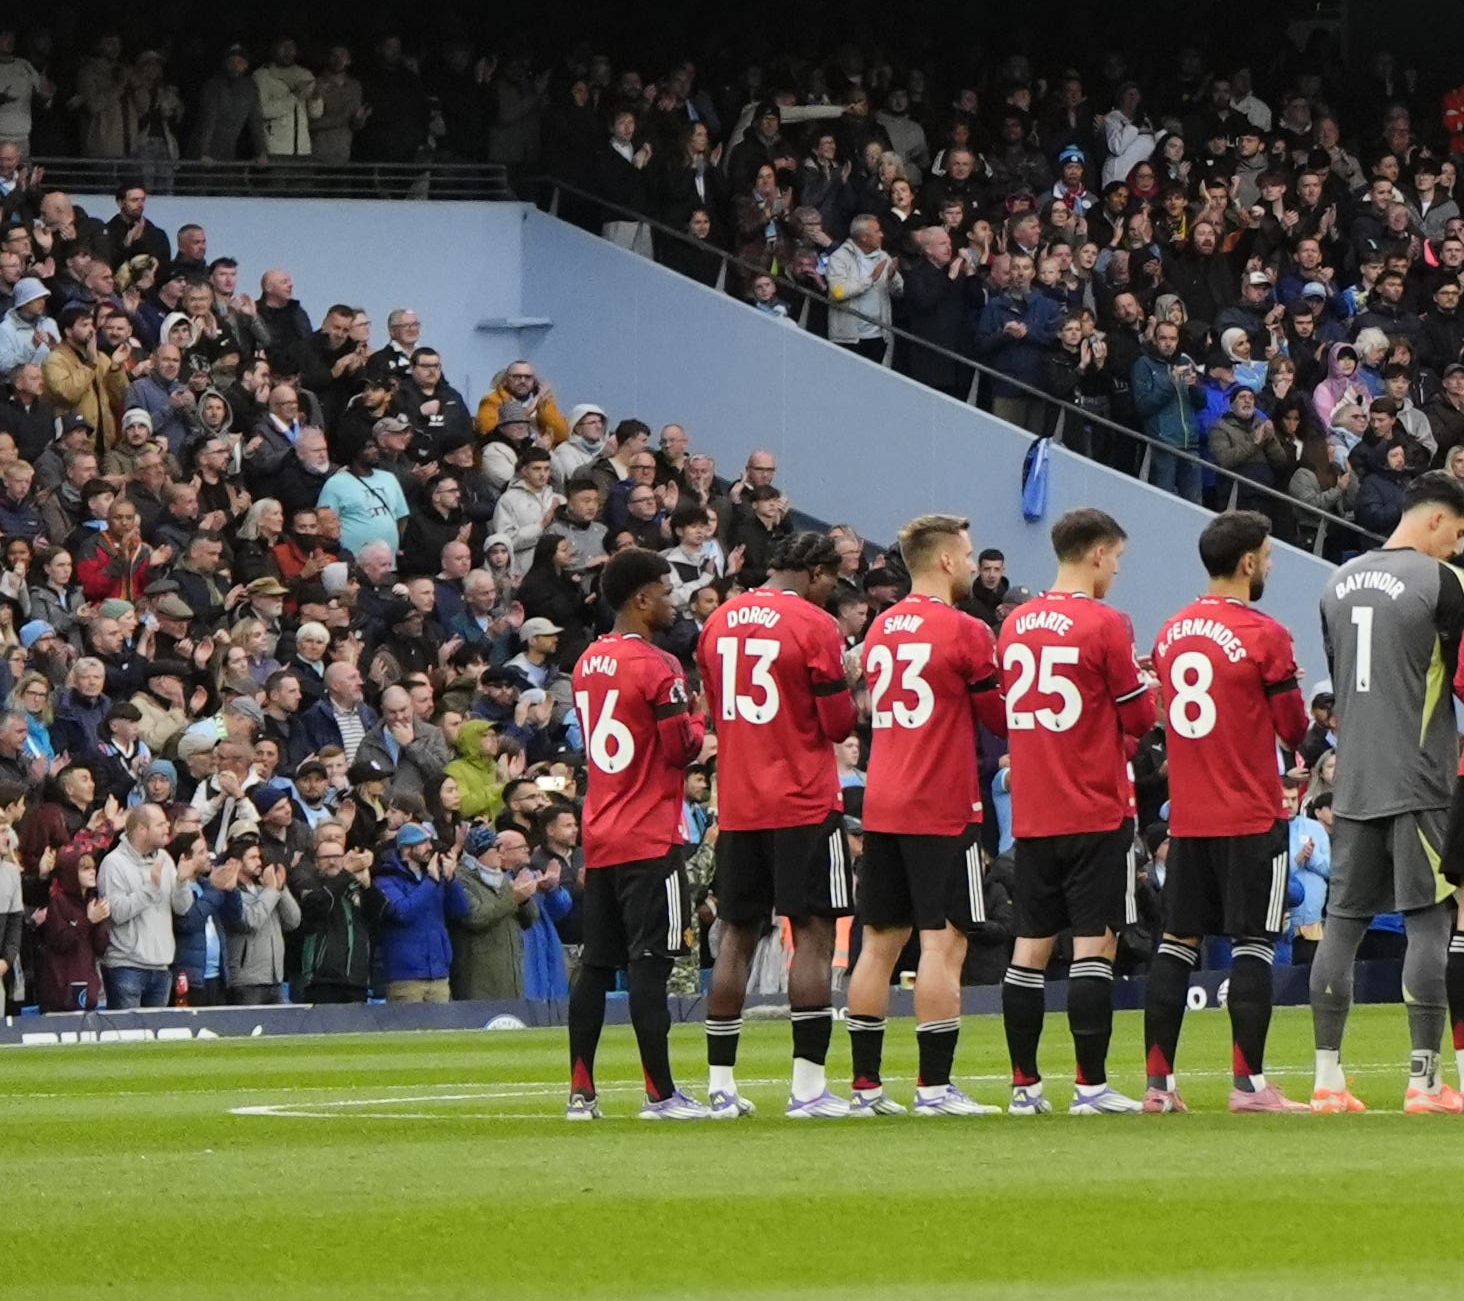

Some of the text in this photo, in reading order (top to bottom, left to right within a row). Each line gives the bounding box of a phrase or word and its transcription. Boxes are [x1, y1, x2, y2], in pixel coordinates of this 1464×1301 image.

[727, 606, 780, 629] DORGU
[883, 612, 925, 635] SHAW
[1015, 611, 1074, 636] UGARTE
[1335, 571, 1406, 601] BAYINDIR
[581, 655, 618, 678] AMAD
[716, 636, 781, 725] 13
[865, 642, 936, 729] 23
[1002, 643, 1083, 732] 25
[1350, 605, 1374, 693] 1
[575, 689, 635, 774] 16
[1169, 651, 1217, 739] 8
